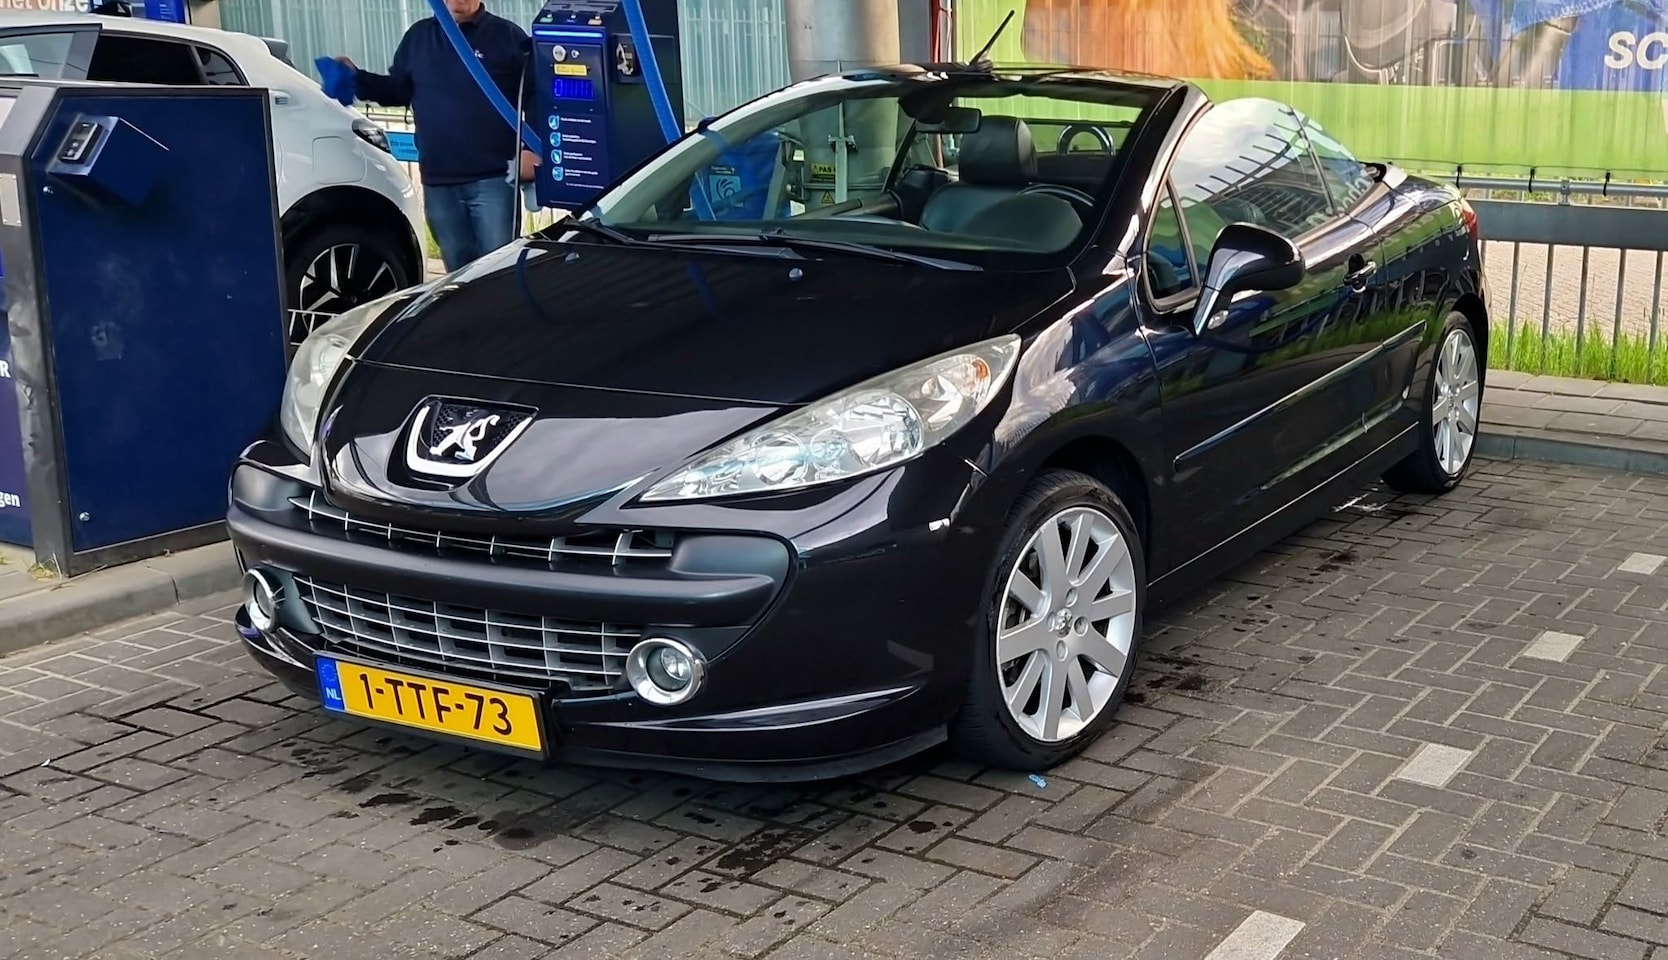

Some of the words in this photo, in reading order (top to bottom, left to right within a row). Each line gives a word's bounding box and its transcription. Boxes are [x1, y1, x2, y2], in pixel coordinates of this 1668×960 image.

[1604, 31, 1668, 69] SC
[325, 687, 341, 700] NL
[359, 673, 513, 736] 1-TTF-73
